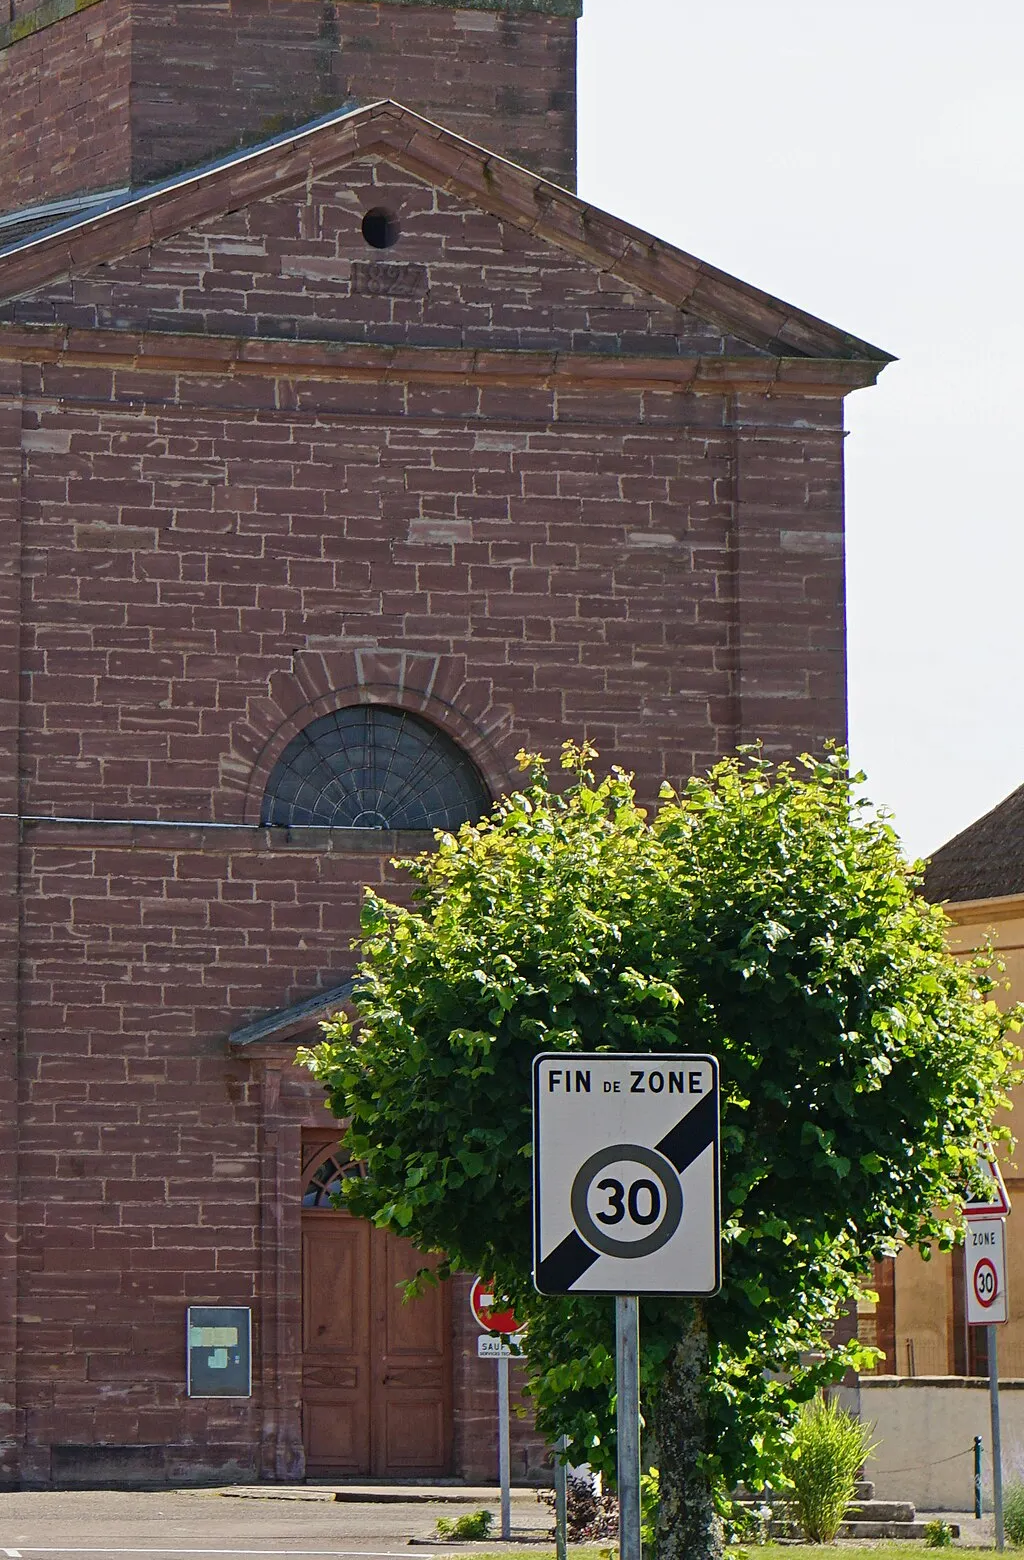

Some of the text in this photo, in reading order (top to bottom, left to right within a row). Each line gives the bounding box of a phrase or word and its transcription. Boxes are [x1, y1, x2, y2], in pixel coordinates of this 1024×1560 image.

[355, 263, 425, 295] 1827
[548, 1070, 703, 1094] FIN DE ZONE
[596, 1178, 661, 1225] 30
[973, 1232, 995, 1246] ZONE
[979, 1273, 993, 1293] 30
